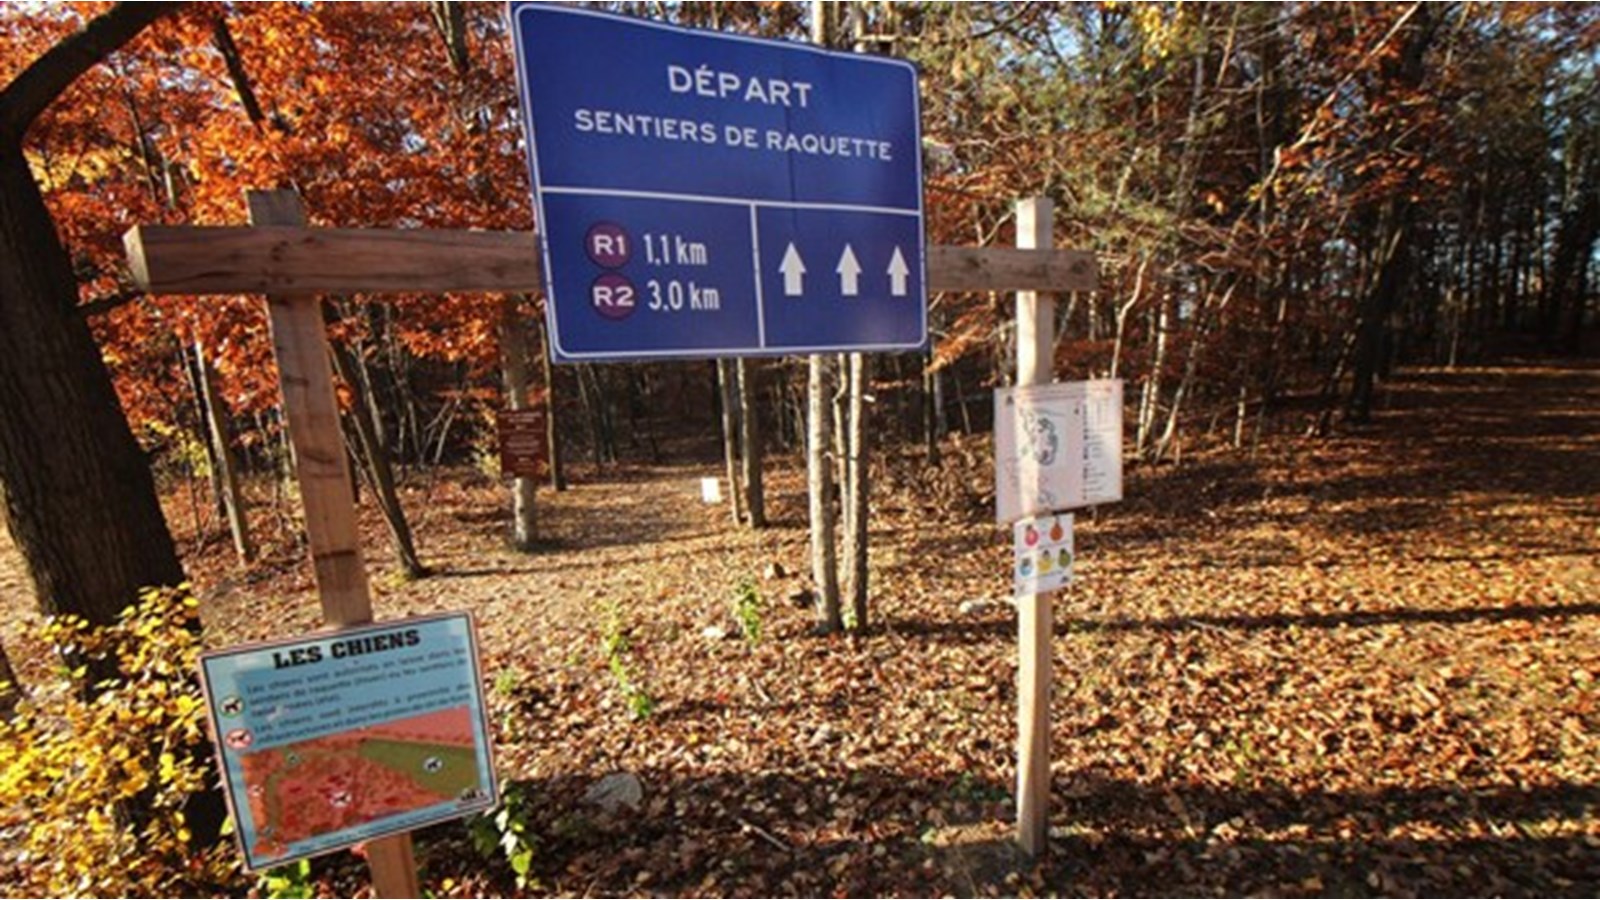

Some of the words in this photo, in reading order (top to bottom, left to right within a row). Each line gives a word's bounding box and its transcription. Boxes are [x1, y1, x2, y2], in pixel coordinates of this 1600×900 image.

[667, 65, 812, 107] DÉPART
[575, 109, 717, 143] SENTIERS
[725, 125, 759, 149] DE
[766, 131, 892, 161] RAQUETTE
[593, 235, 625, 255] R1
[676, 235, 707, 265] km
[594, 286, 634, 306] R2
[689, 282, 720, 310] km
[273, 647, 322, 669] LES
[330, 629, 420, 658] CHIENS
